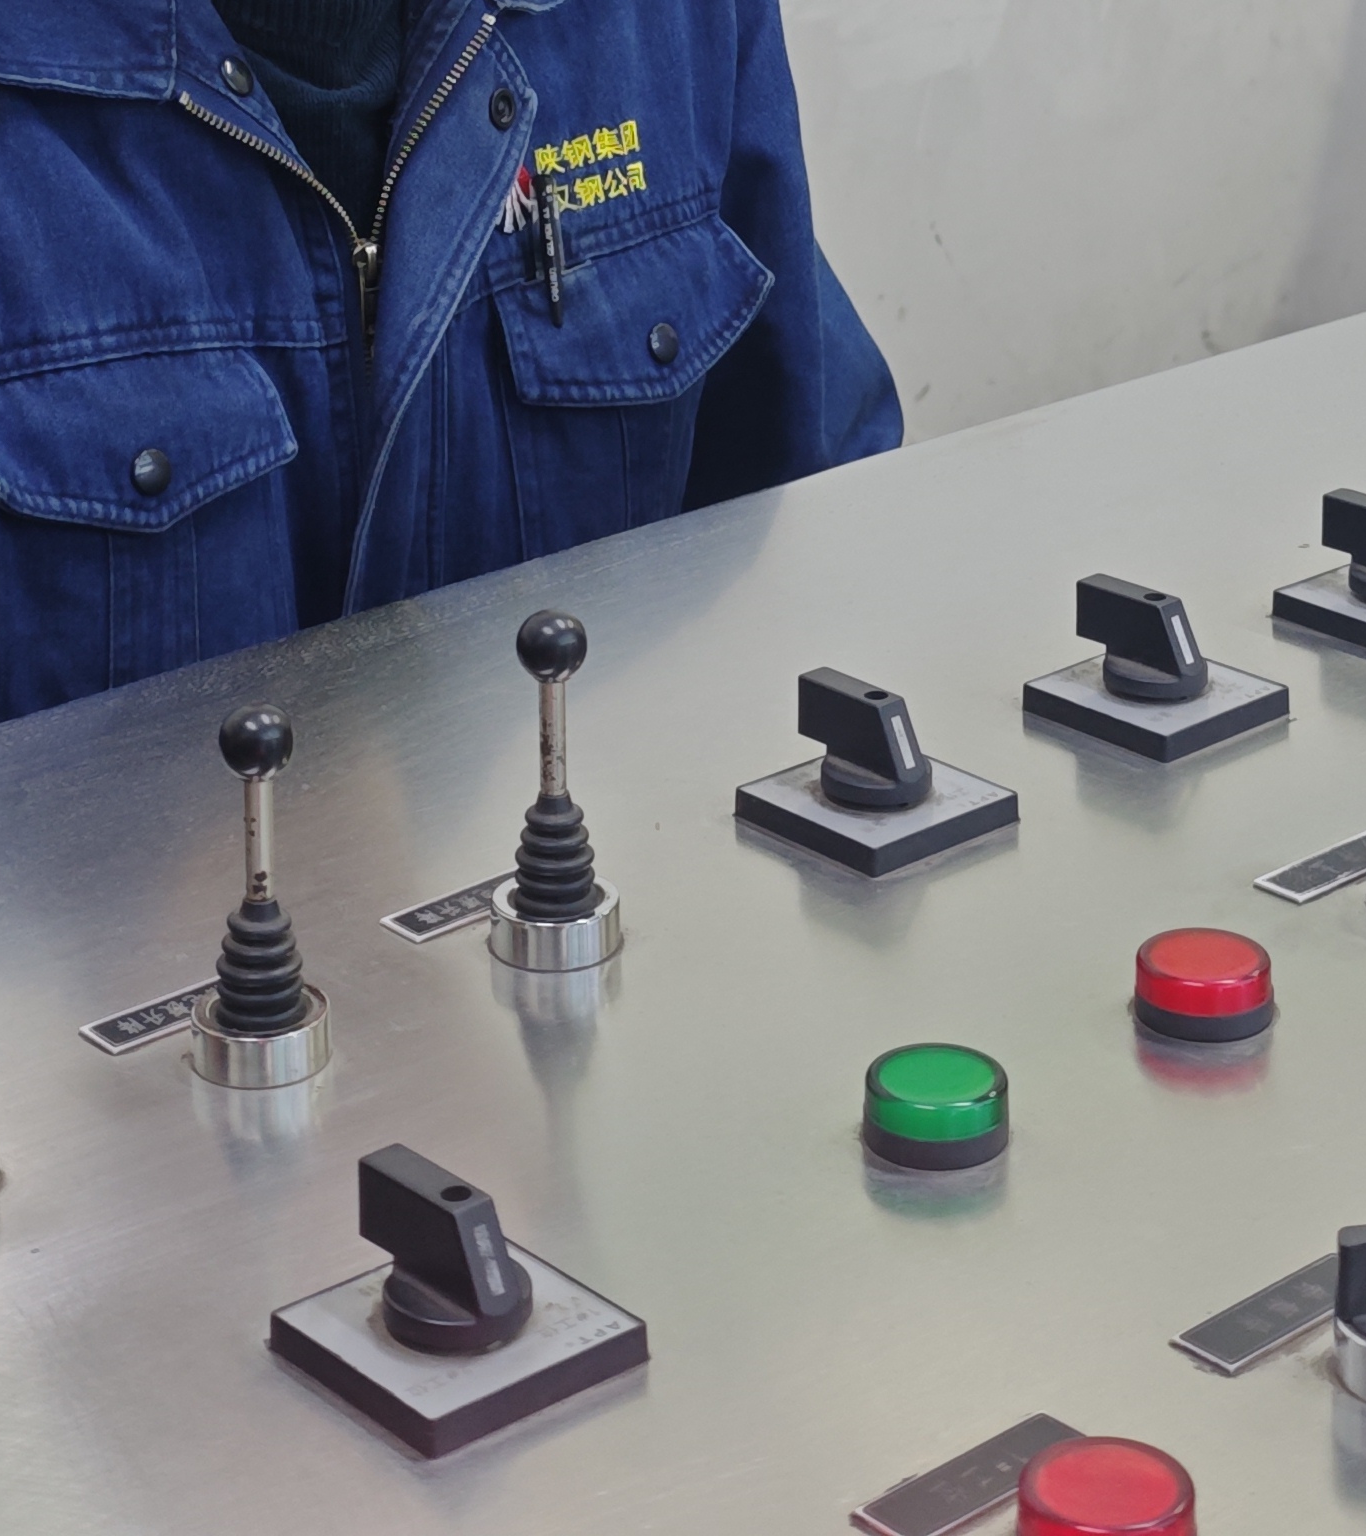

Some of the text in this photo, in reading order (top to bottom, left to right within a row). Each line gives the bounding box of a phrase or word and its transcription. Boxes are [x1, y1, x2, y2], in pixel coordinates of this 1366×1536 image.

[533, 119, 639, 174] 陕钢集团
[578, 1321, 621, 1345] APT
